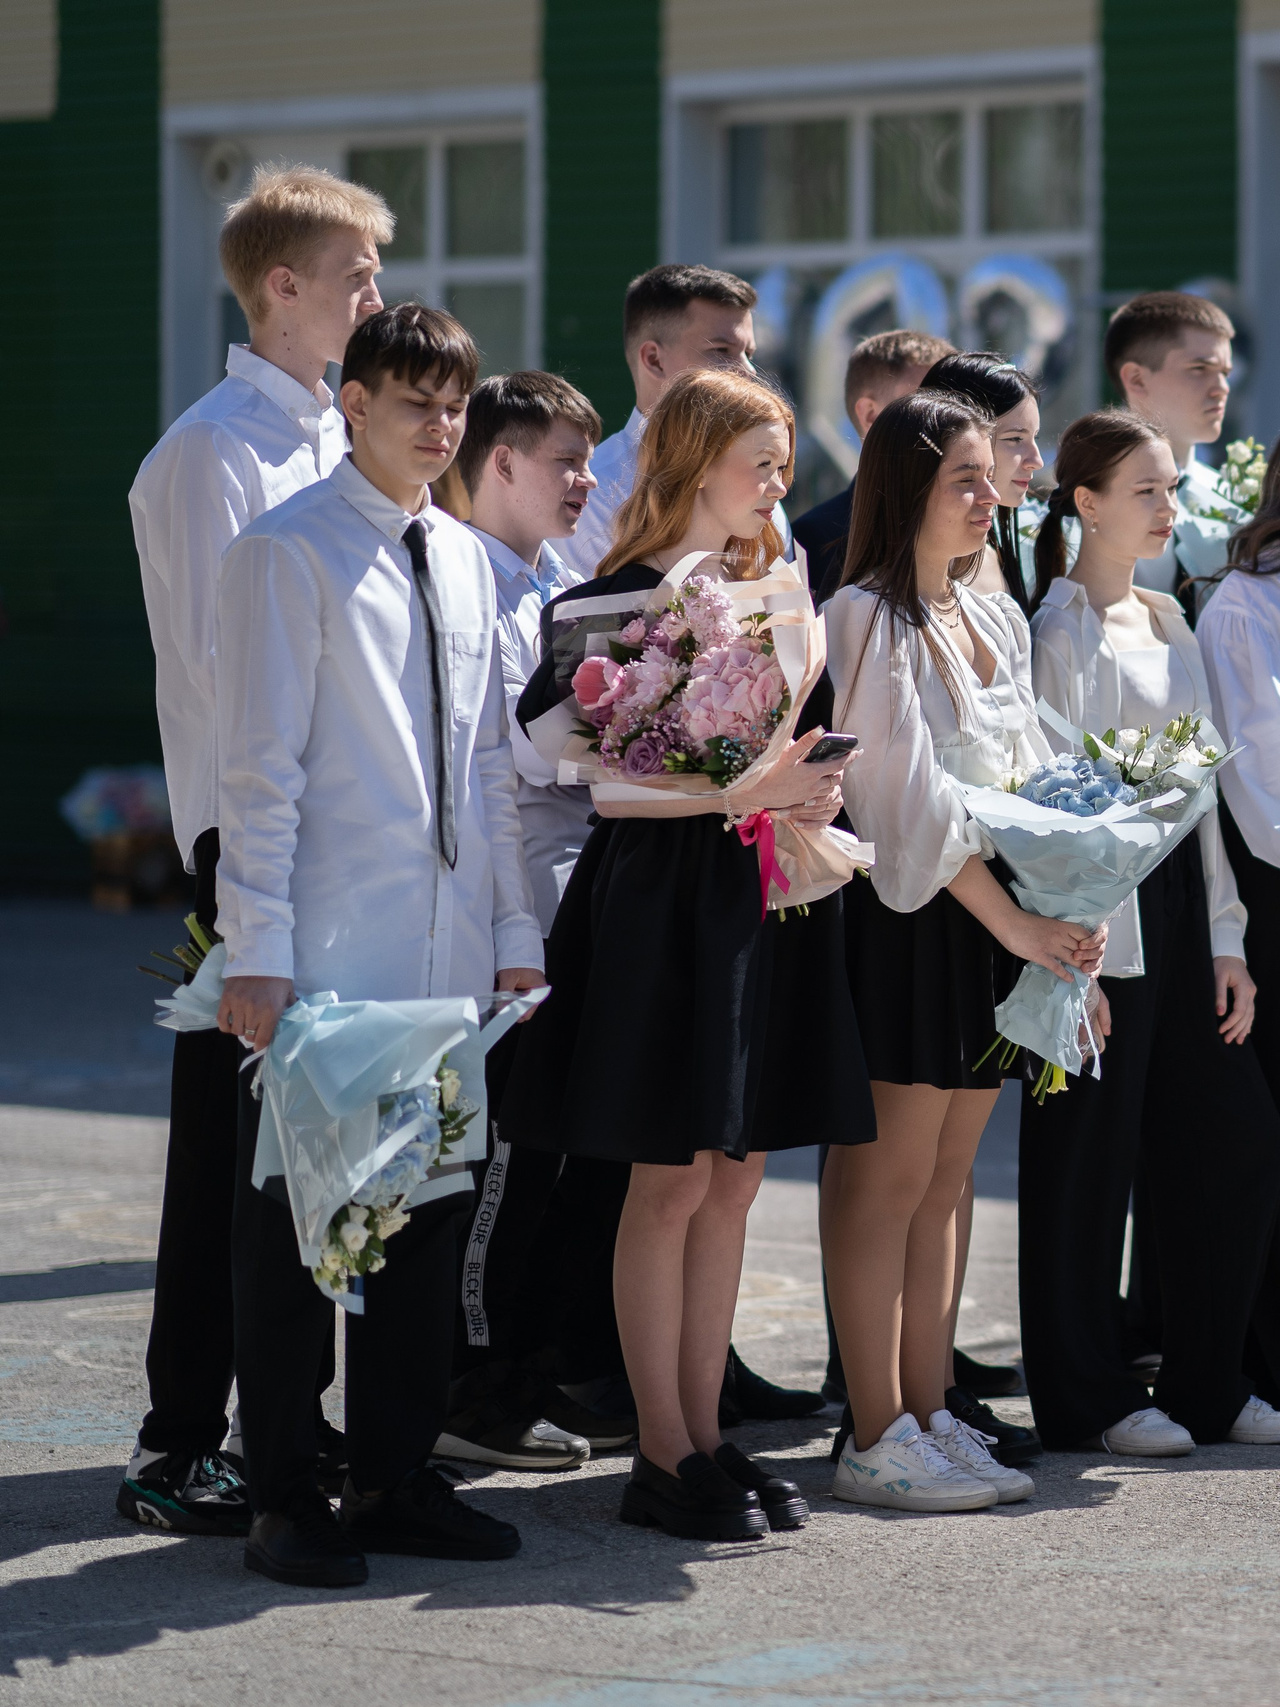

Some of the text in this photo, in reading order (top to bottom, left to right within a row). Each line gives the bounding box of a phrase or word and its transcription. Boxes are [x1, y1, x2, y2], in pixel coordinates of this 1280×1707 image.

[472, 1162, 503, 1245] BLCK FOUR
[466, 1262, 485, 1337] BLCK FOUR
[887, 1457, 909, 1472] Reebok
